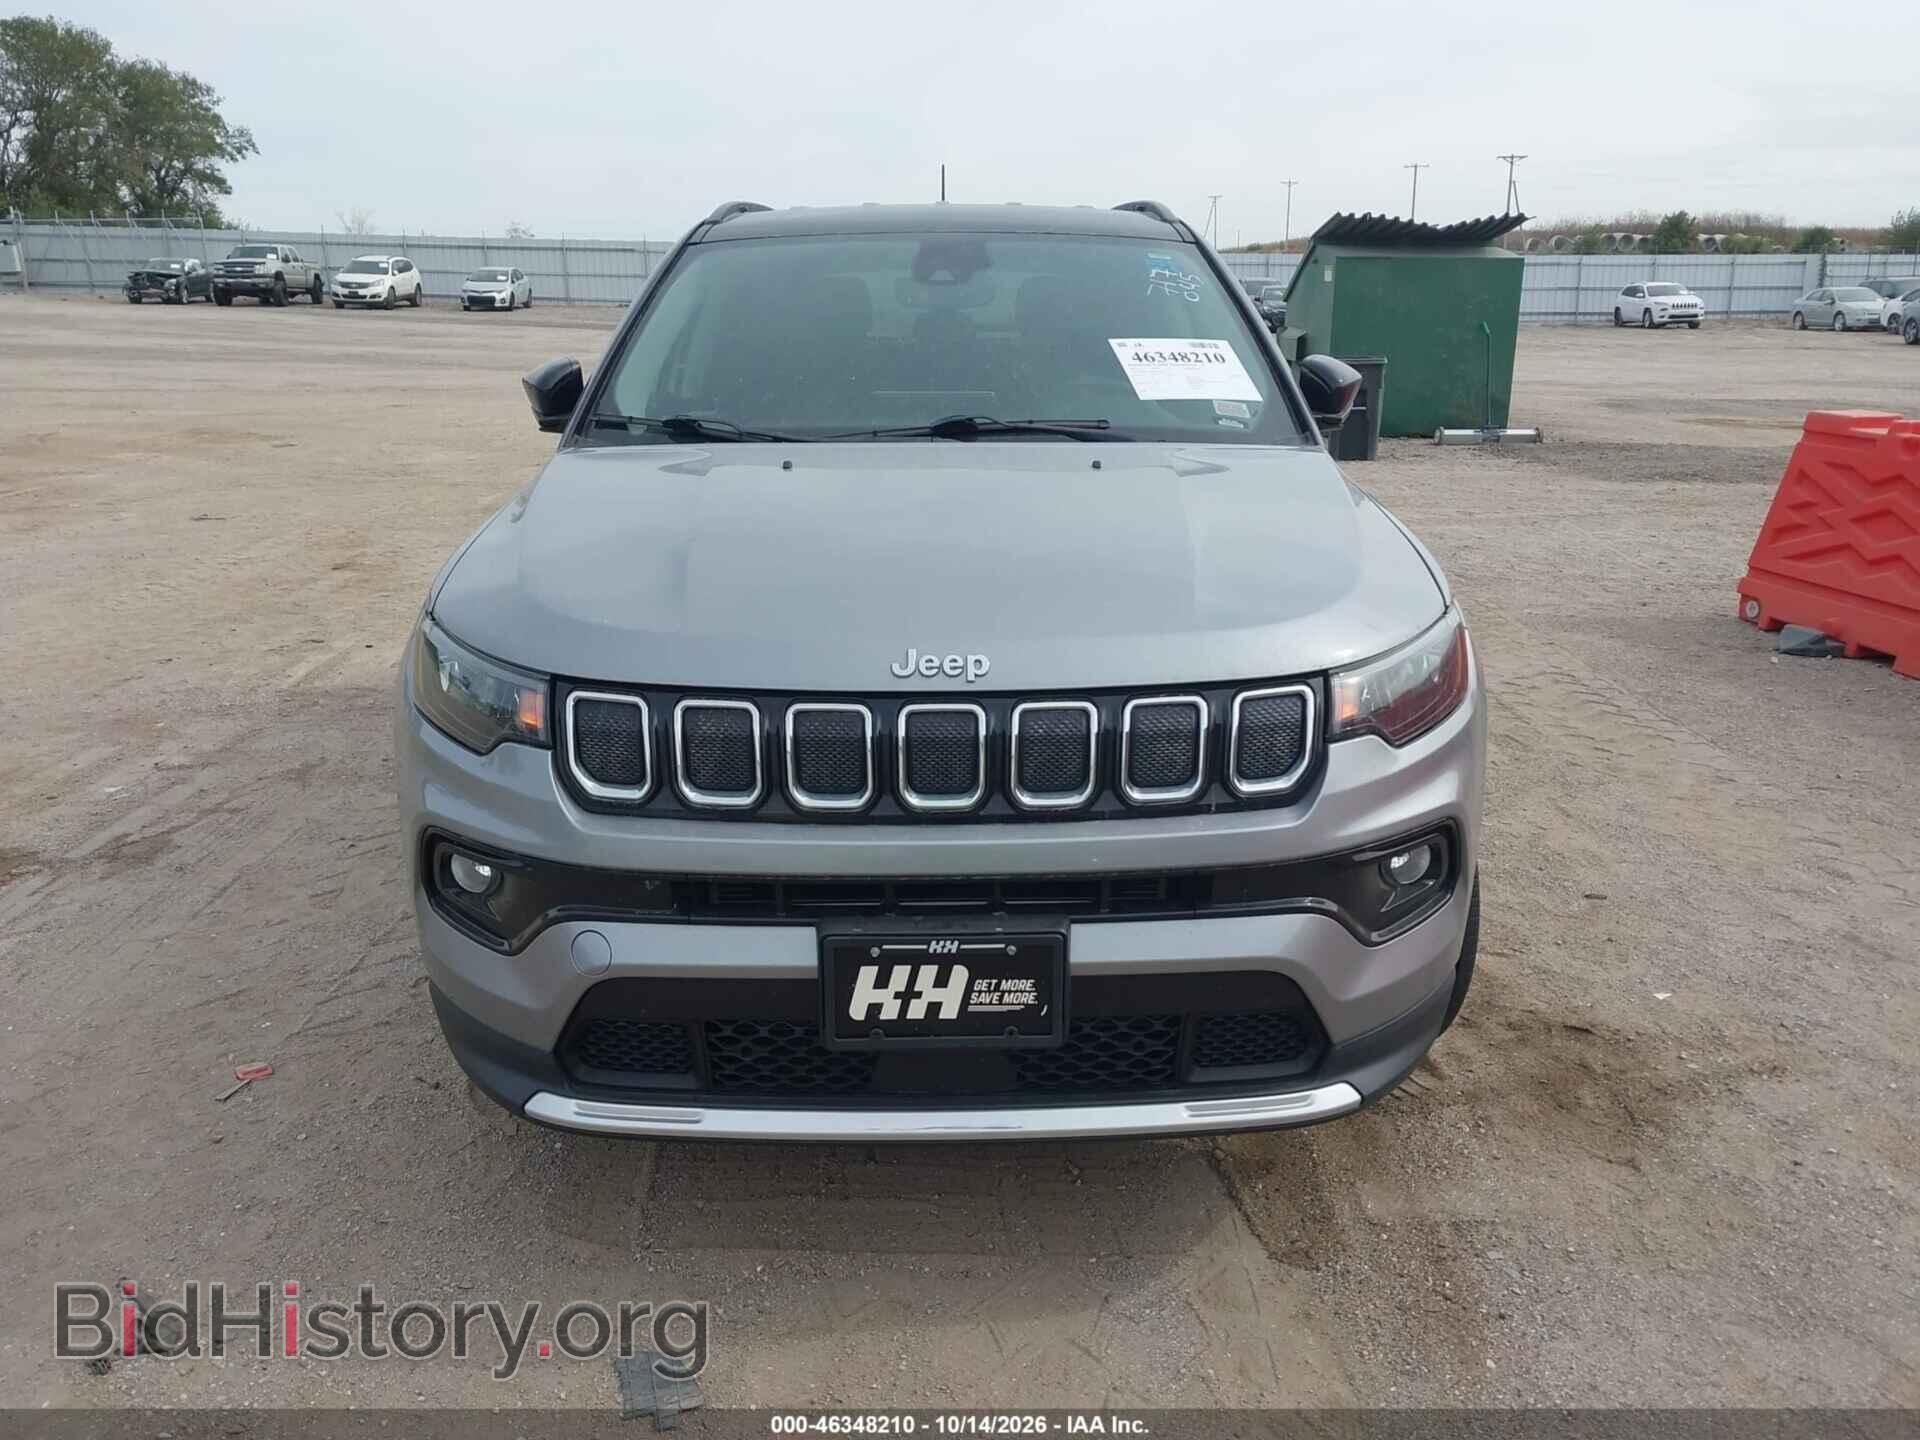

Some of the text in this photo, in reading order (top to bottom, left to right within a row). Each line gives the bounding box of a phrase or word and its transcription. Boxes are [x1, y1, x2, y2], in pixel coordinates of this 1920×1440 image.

[1131, 350, 1226, 364] 46348210
[890, 648, 991, 683] Jeep
[973, 979, 1036, 991] GET MORE.
[969, 992, 1039, 1004] SAVE MORE.
